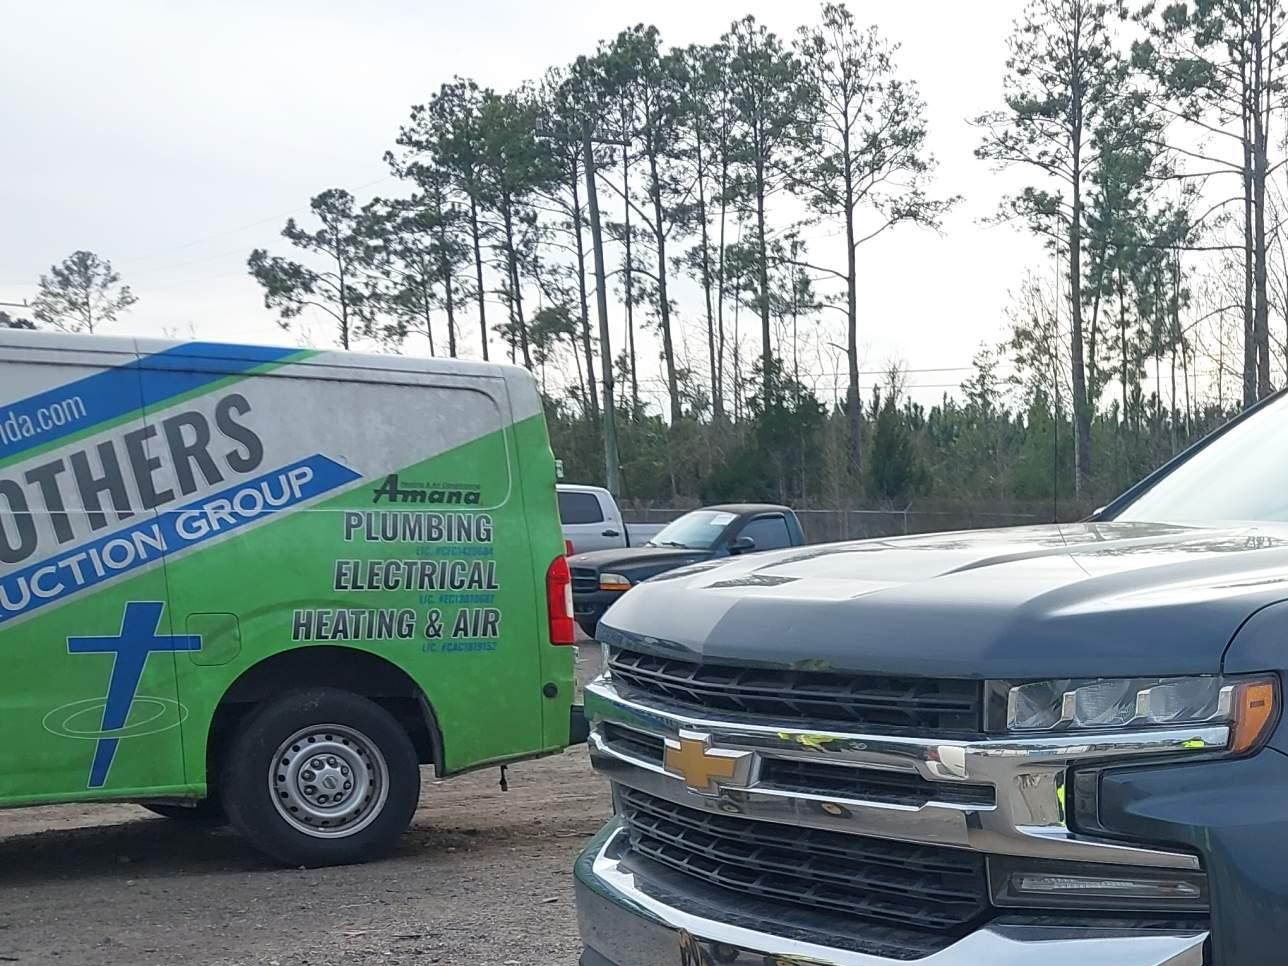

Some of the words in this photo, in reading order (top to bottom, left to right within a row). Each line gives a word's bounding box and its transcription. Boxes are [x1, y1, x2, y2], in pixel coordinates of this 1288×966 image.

[0, 393, 264, 564] OTHERS
[372, 473, 480, 505] Amana
[0, 524, 168, 612] UCTION
[175, 466, 314, 540] GROUP
[344, 511, 493, 543] PLUMBING
[334, 559, 500, 591] ELECTRICAL
[291, 608, 417, 641] HEATING
[425, 607, 444, 640] &
[450, 607, 501, 640] AIR
